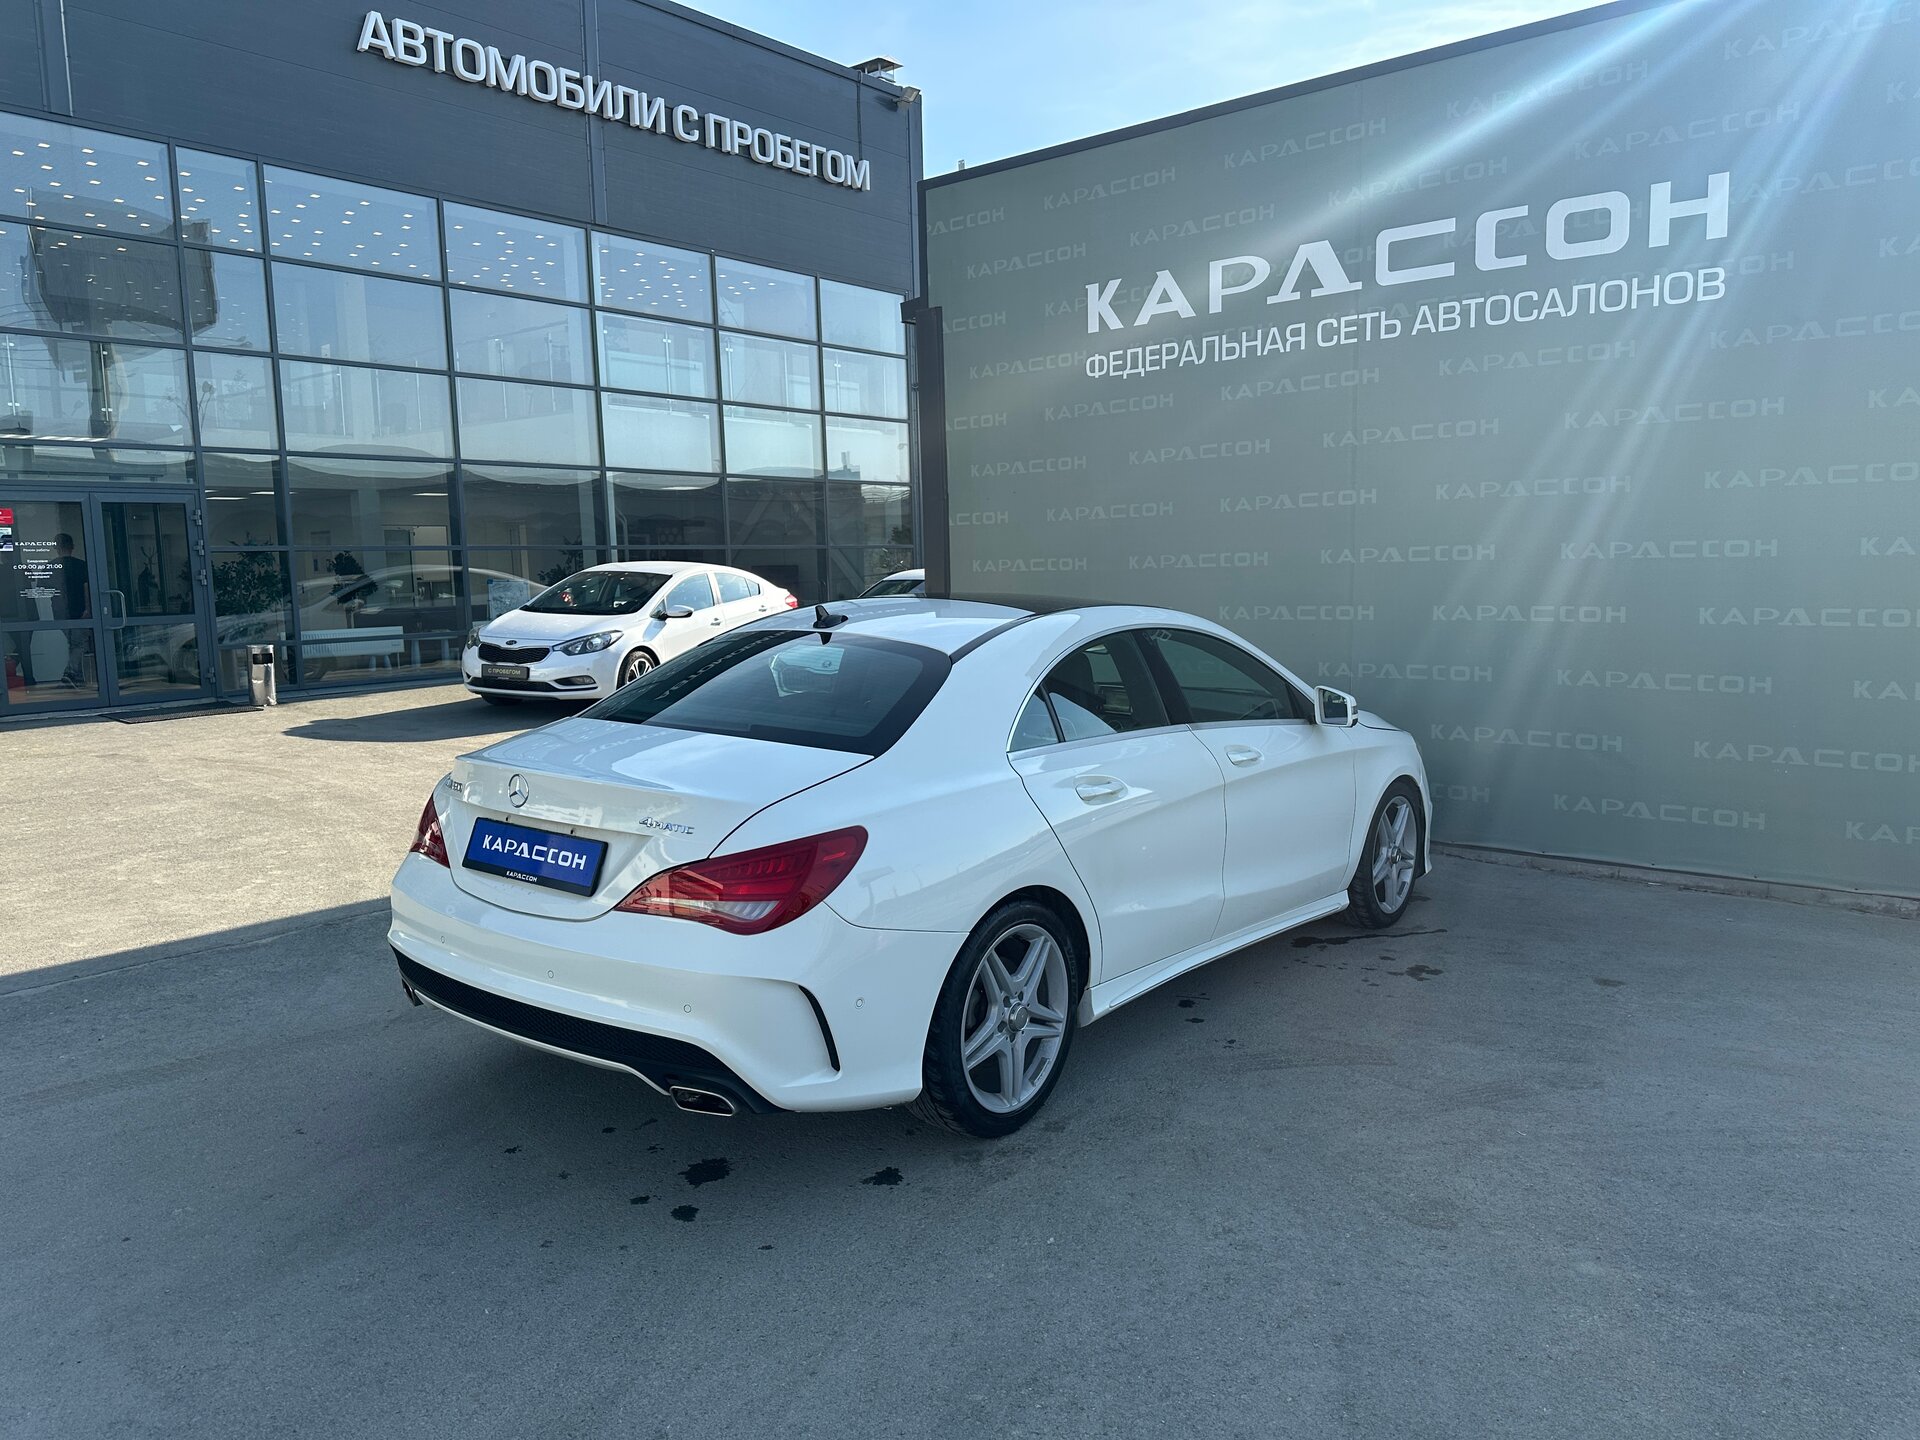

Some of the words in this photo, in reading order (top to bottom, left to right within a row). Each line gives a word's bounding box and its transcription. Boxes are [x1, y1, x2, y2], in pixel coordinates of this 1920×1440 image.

[356, 10, 666, 134] АВТОМОБИЛИ
[672, 103, 699, 143] С
[705, 112, 871, 192] ПРОБЕГОМ
[1085, 171, 1730, 335] КАРАССОН
[1085, 322, 1306, 380] ФЕДЕРАЛЬНАЯ
[1316, 310, 1401, 348] СЕТЬ
[1411, 266, 1727, 337] АВТОСАЛОНОВ
[1699, 607, 1920, 628] КАРАССО
[639, 816, 695, 835] 4MATIC
[482, 833, 587, 871] КАРАССОН
[506, 870, 538, 883] КАРАССОН
